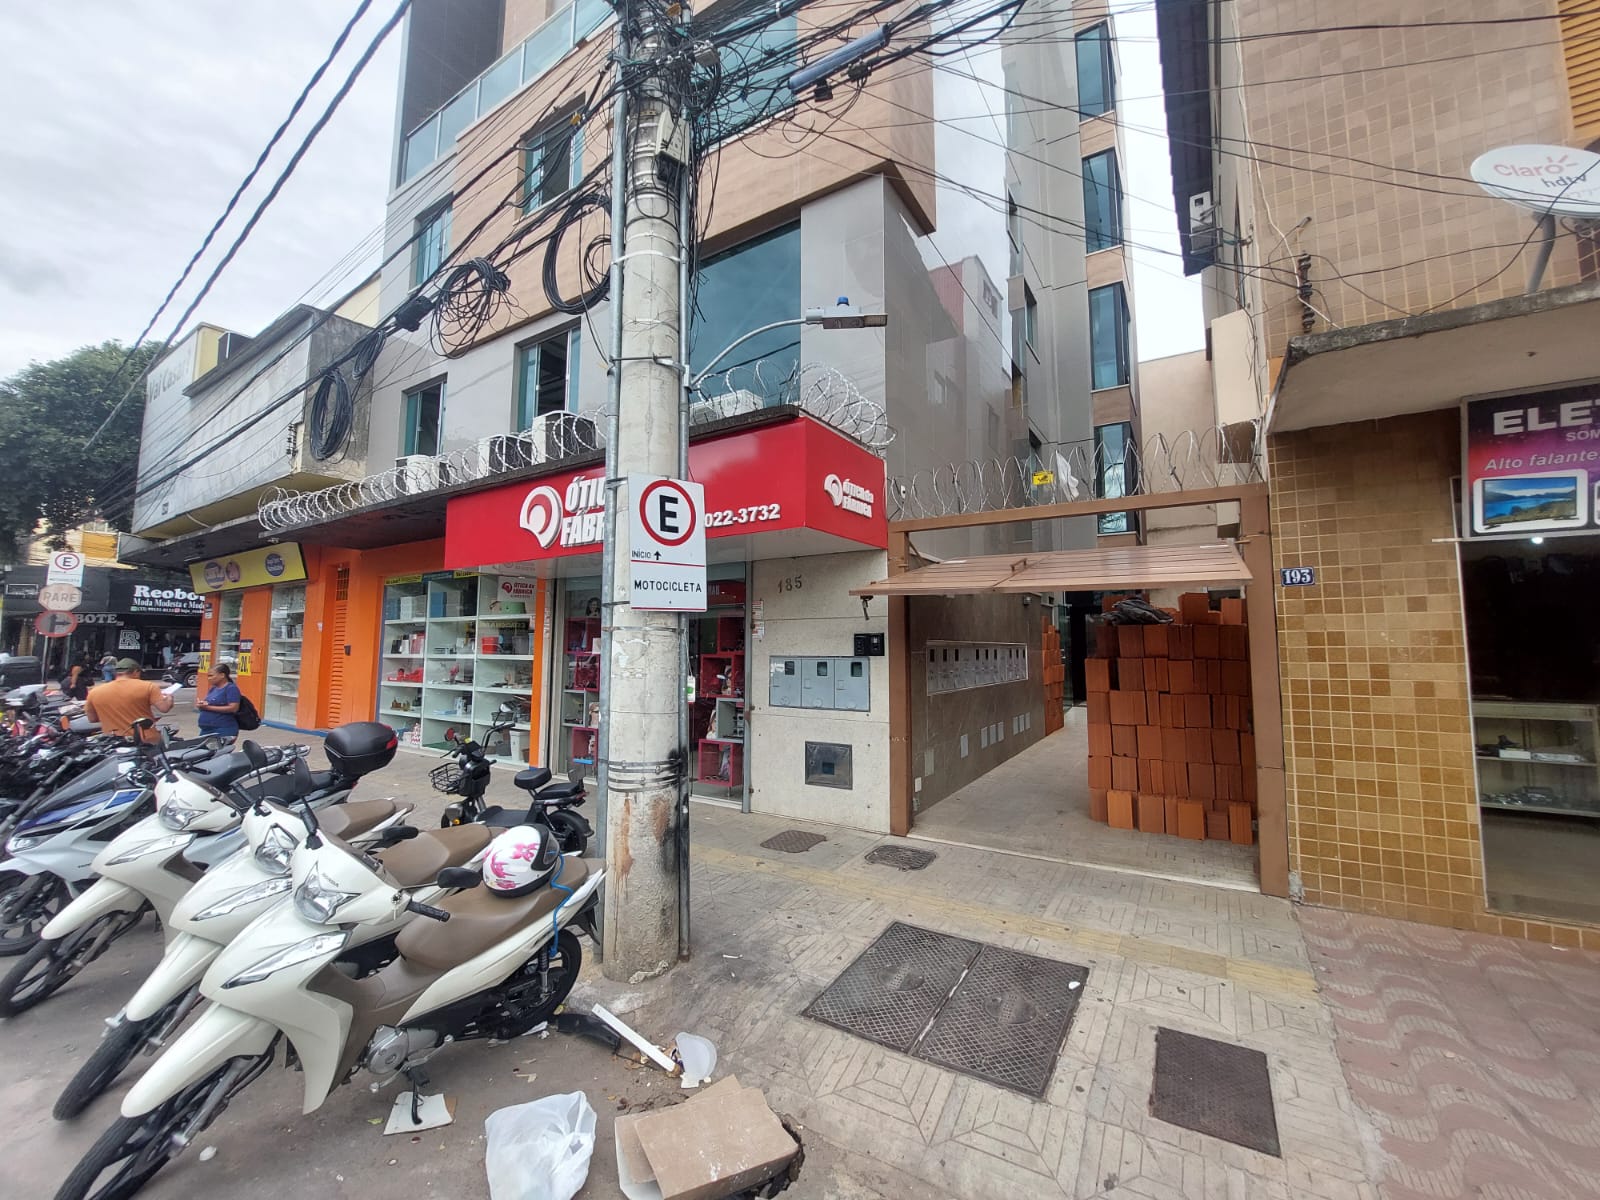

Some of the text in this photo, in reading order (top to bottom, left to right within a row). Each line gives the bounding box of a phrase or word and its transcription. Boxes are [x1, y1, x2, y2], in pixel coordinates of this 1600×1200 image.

[1493, 163, 1564, 177] Claro
[1541, 173, 1587, 188] hdtv
[1484, 450, 1600, 471] Alto falante
[659, 494, 680, 533] E
[704, 503, 781, 528] 022-3732
[62, 556, 73, 567] E
[631, 550, 652, 559] INÍCIO
[778, 574, 802, 593] 185
[1285, 569, 1311, 584] 193
[133, 585, 205, 601] Reobo
[634, 579, 702, 593] MOTOCICLETA
[43, 592, 79, 603] PARE
[132, 598, 153, 607] Moda
[154, 599, 182, 608] Modesta
